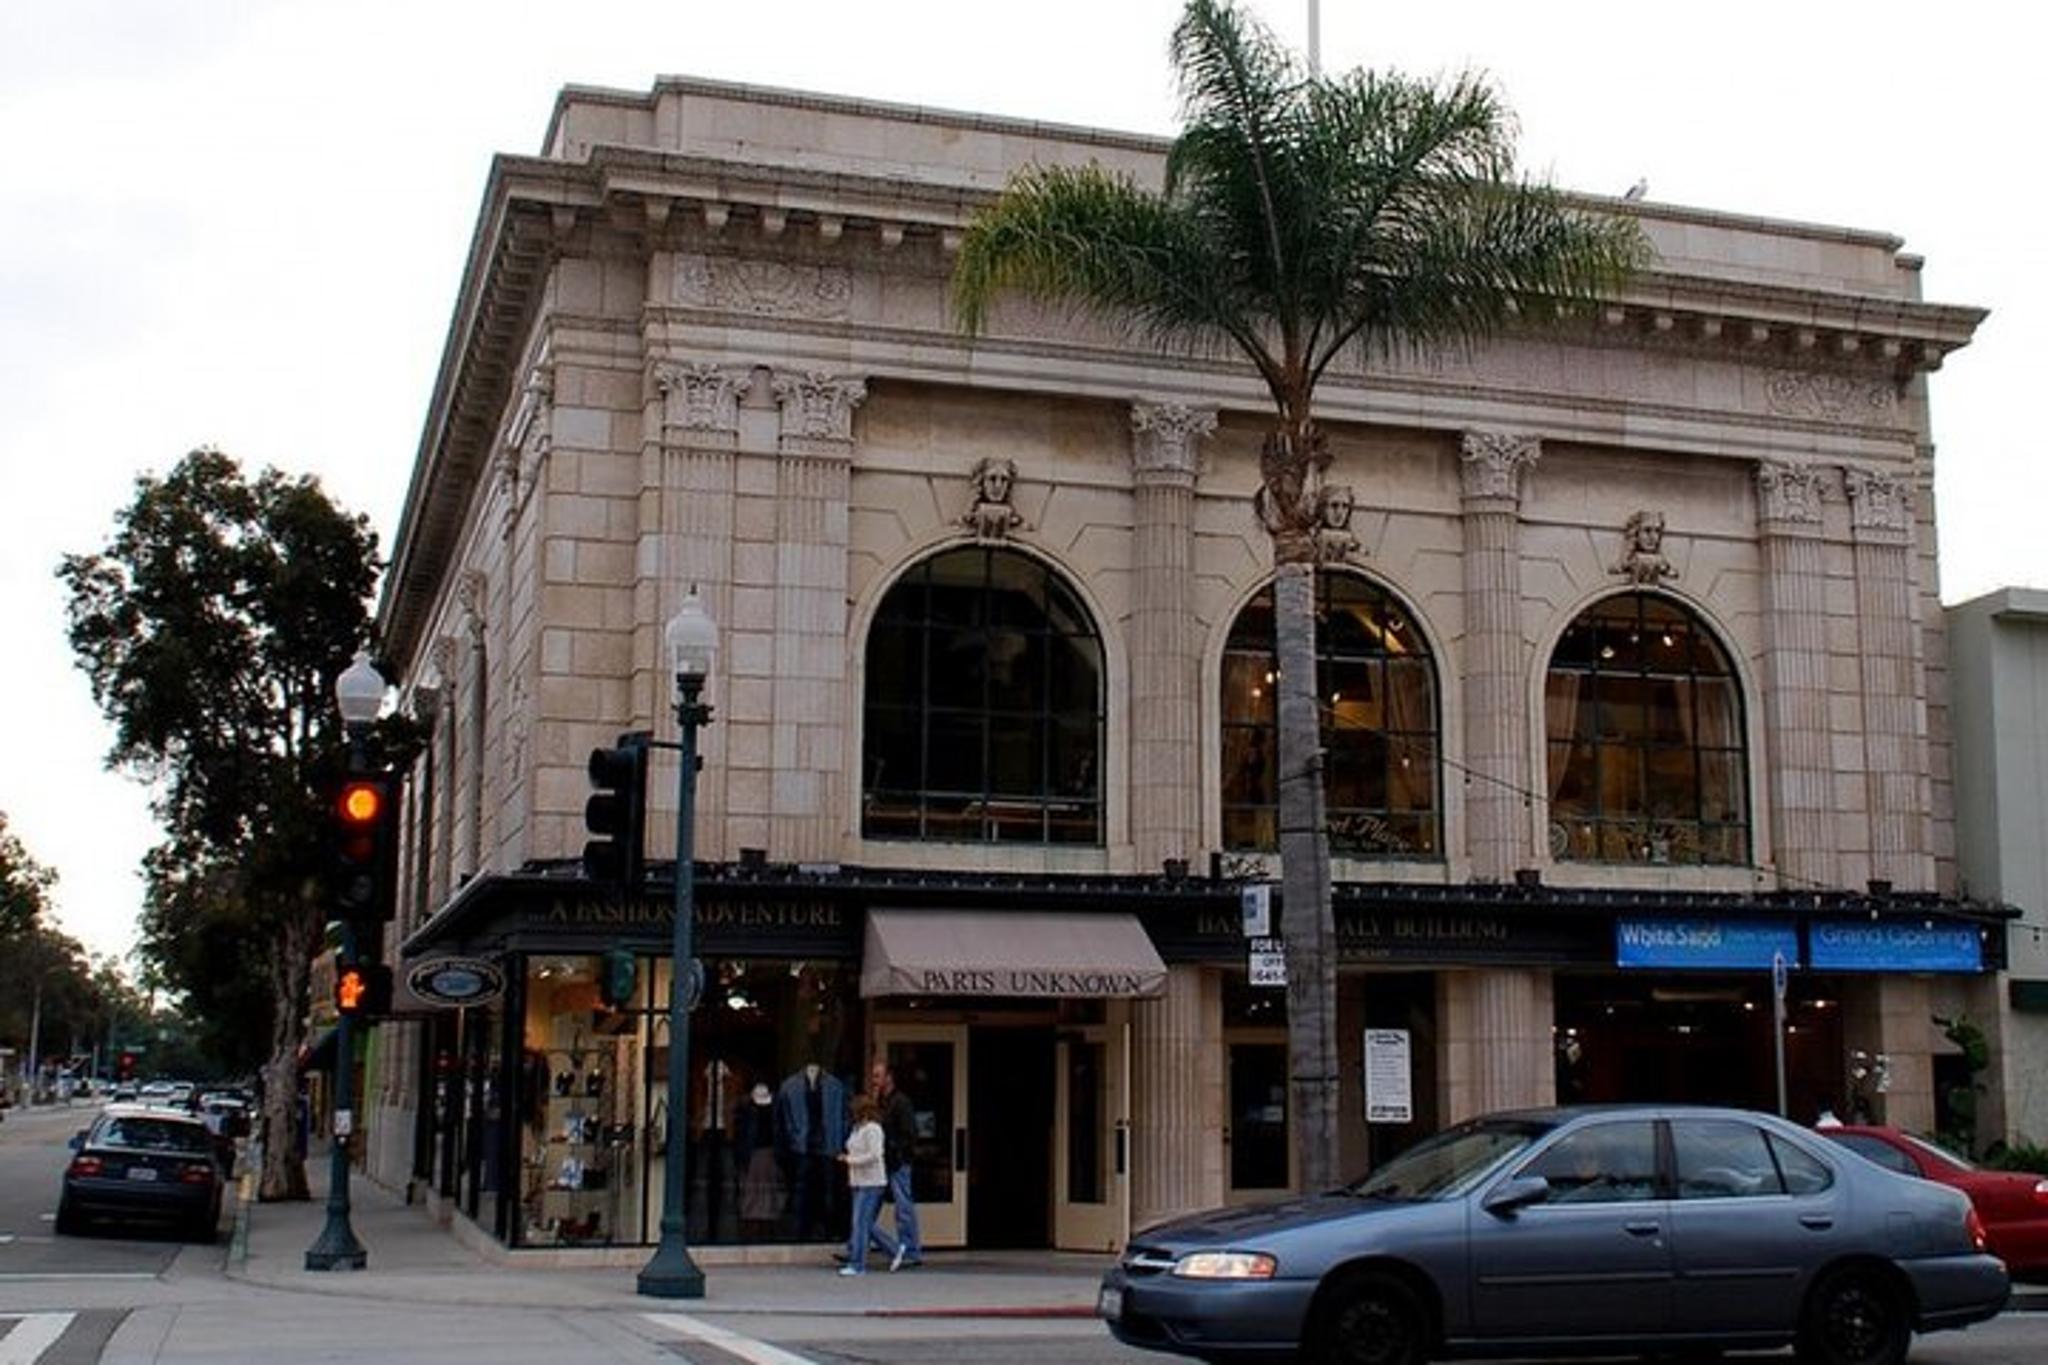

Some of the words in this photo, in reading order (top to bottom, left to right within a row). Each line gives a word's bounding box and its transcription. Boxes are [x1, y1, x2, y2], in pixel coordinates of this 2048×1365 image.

[576, 899, 677, 924] FASHION
[1393, 913, 1507, 939] BUILDING
[1819, 923, 1882, 945] Grand
[1887, 925, 1972, 951] Opening
[921, 970, 995, 992] PARTS
[1010, 971, 1142, 993] UNKNOWN
